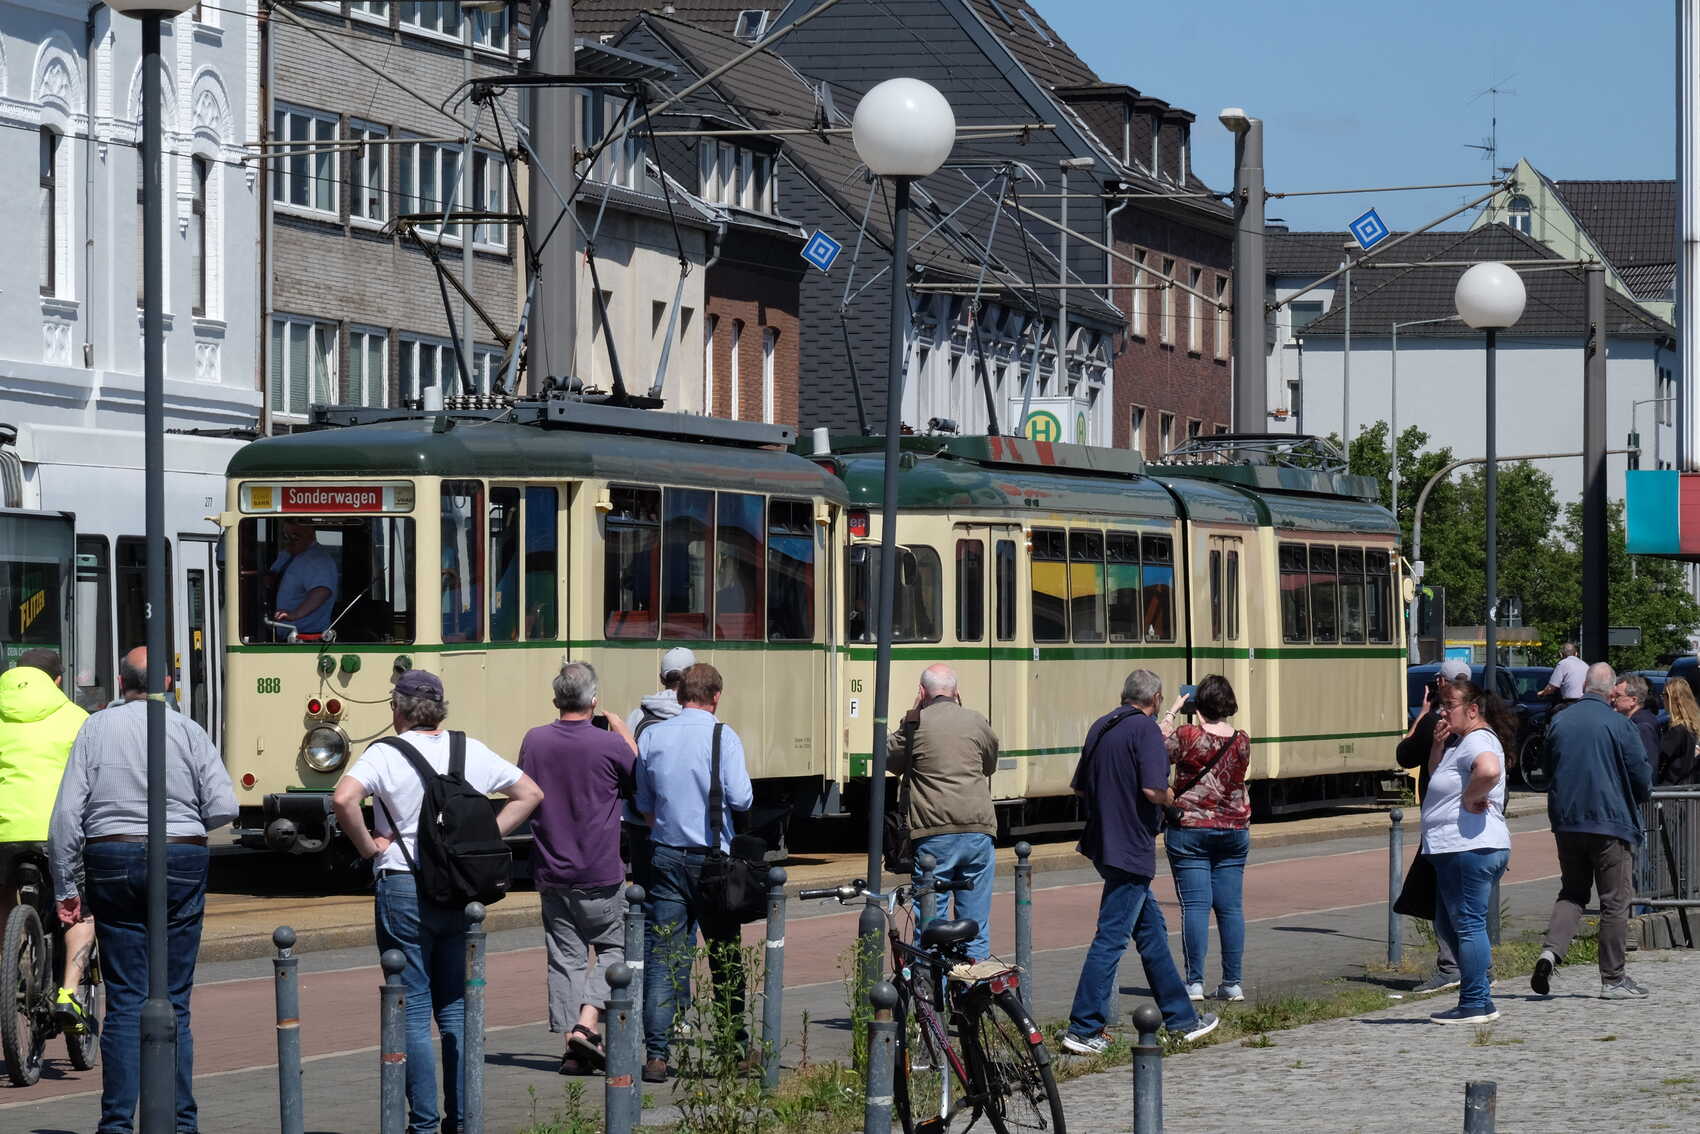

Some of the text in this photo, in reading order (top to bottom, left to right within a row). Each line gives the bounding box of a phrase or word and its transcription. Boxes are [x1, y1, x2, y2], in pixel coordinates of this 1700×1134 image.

[1031, 420, 1050, 442] H
[289, 488, 376, 507] Sonderwagen
[145, 602, 152, 619] 3
[257, 677, 281, 694] 888
[849, 679, 863, 693] 05
[850, 701, 857, 715] F
